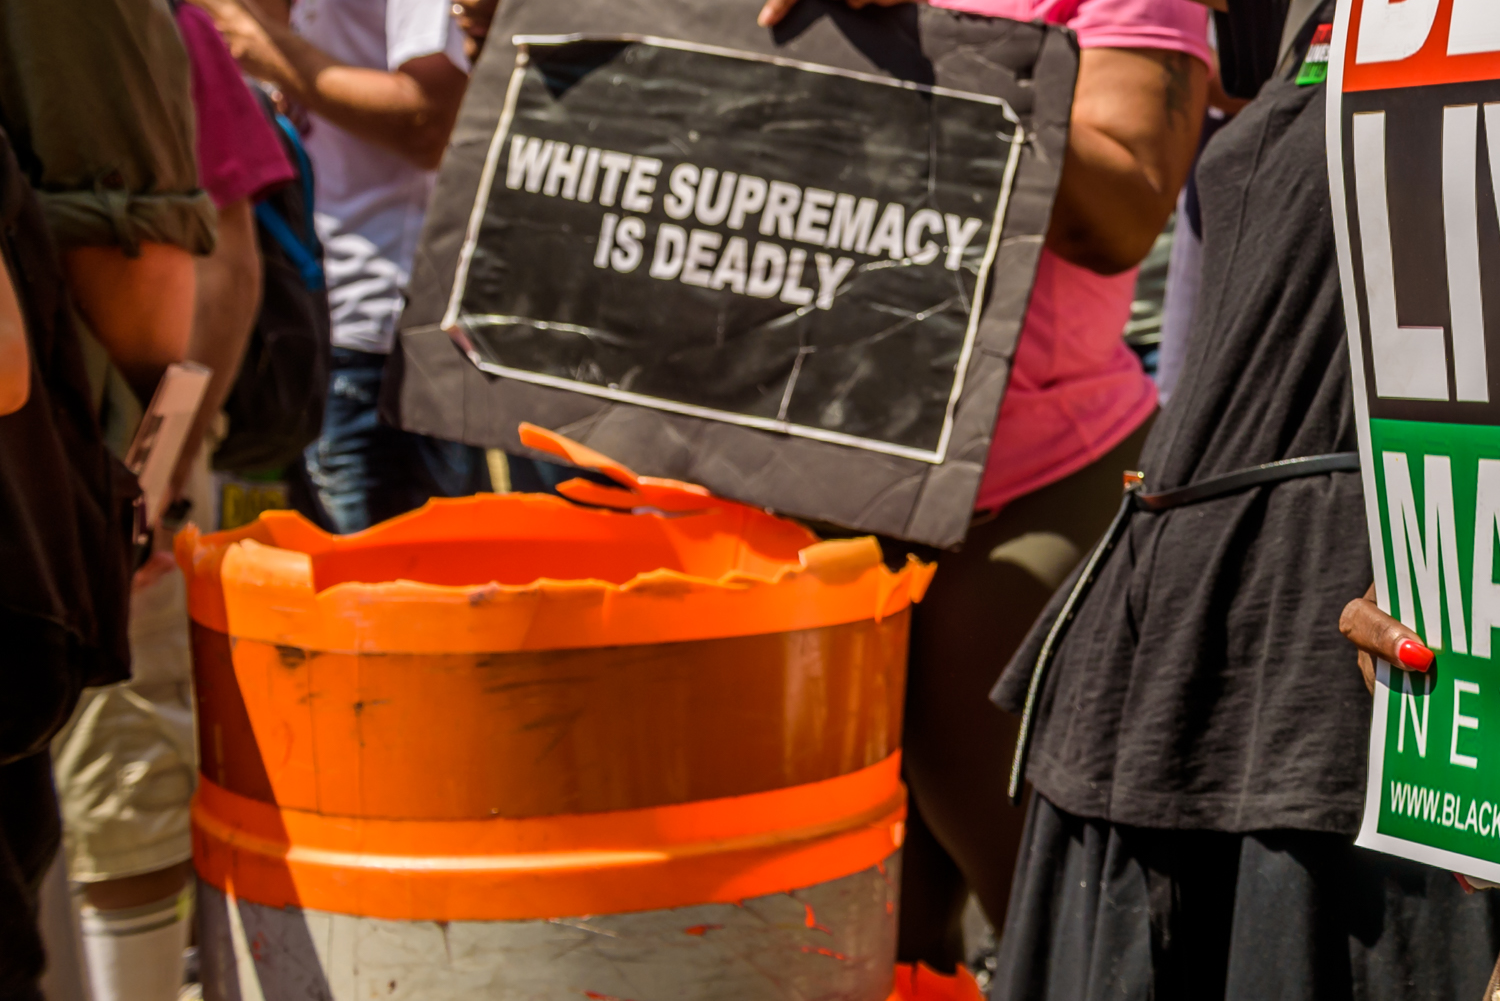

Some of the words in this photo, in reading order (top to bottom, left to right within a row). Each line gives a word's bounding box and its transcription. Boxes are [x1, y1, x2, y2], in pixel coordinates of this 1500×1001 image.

[505, 135, 661, 213] WHITE
[663, 163, 981, 273] SUPREMACY
[594, 212, 645, 273] IS
[650, 225, 856, 311] DEADLY
